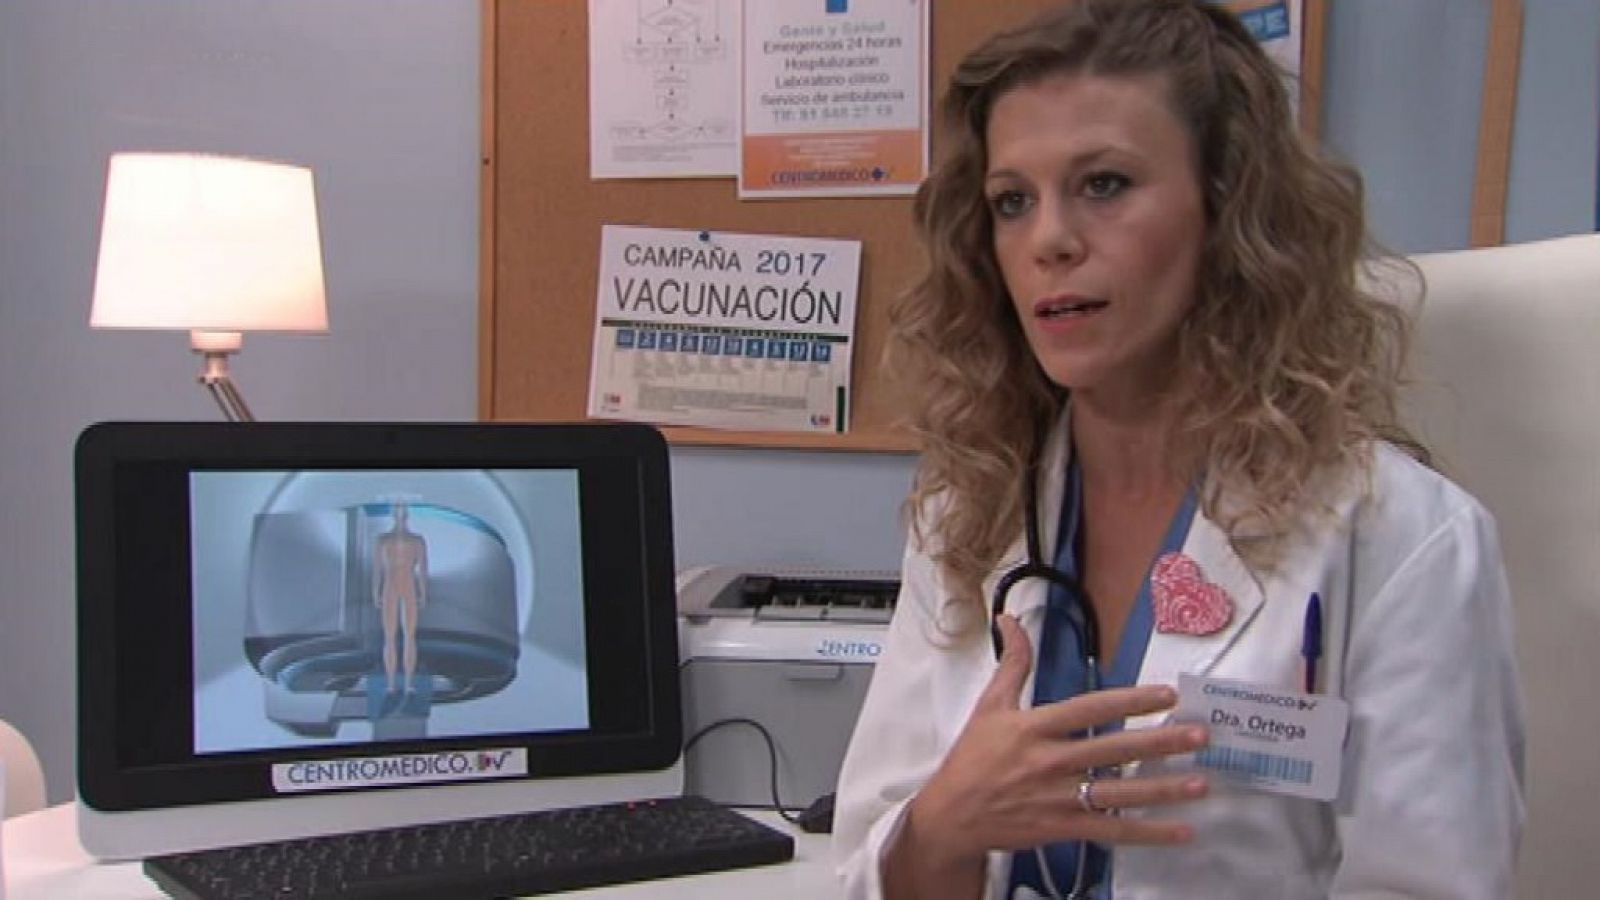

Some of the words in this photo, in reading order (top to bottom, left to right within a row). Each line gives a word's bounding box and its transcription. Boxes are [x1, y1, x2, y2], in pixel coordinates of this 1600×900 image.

[779, 24, 824, 38] Gente
[828, 24, 839, 36] y
[842, 20, 886, 35] Salud
[763, 39, 844, 54] Emergencias
[847, 37, 863, 49] 24
[865, 36, 903, 49] horas
[775, 74, 846, 89] Laboratorio
[760, 93, 810, 106] Servicio
[812, 91, 829, 104] de
[831, 90, 906, 103] ambulancia
[624, 243, 742, 272] CAMPAÑA
[756, 250, 827, 276] 2017
[613, 275, 842, 325] VACUNACIÓN
[1203, 683, 1297, 708] CENTROMEDICO
[1211, 708, 1245, 728] Dra.
[1248, 715, 1306, 740] Ortega
